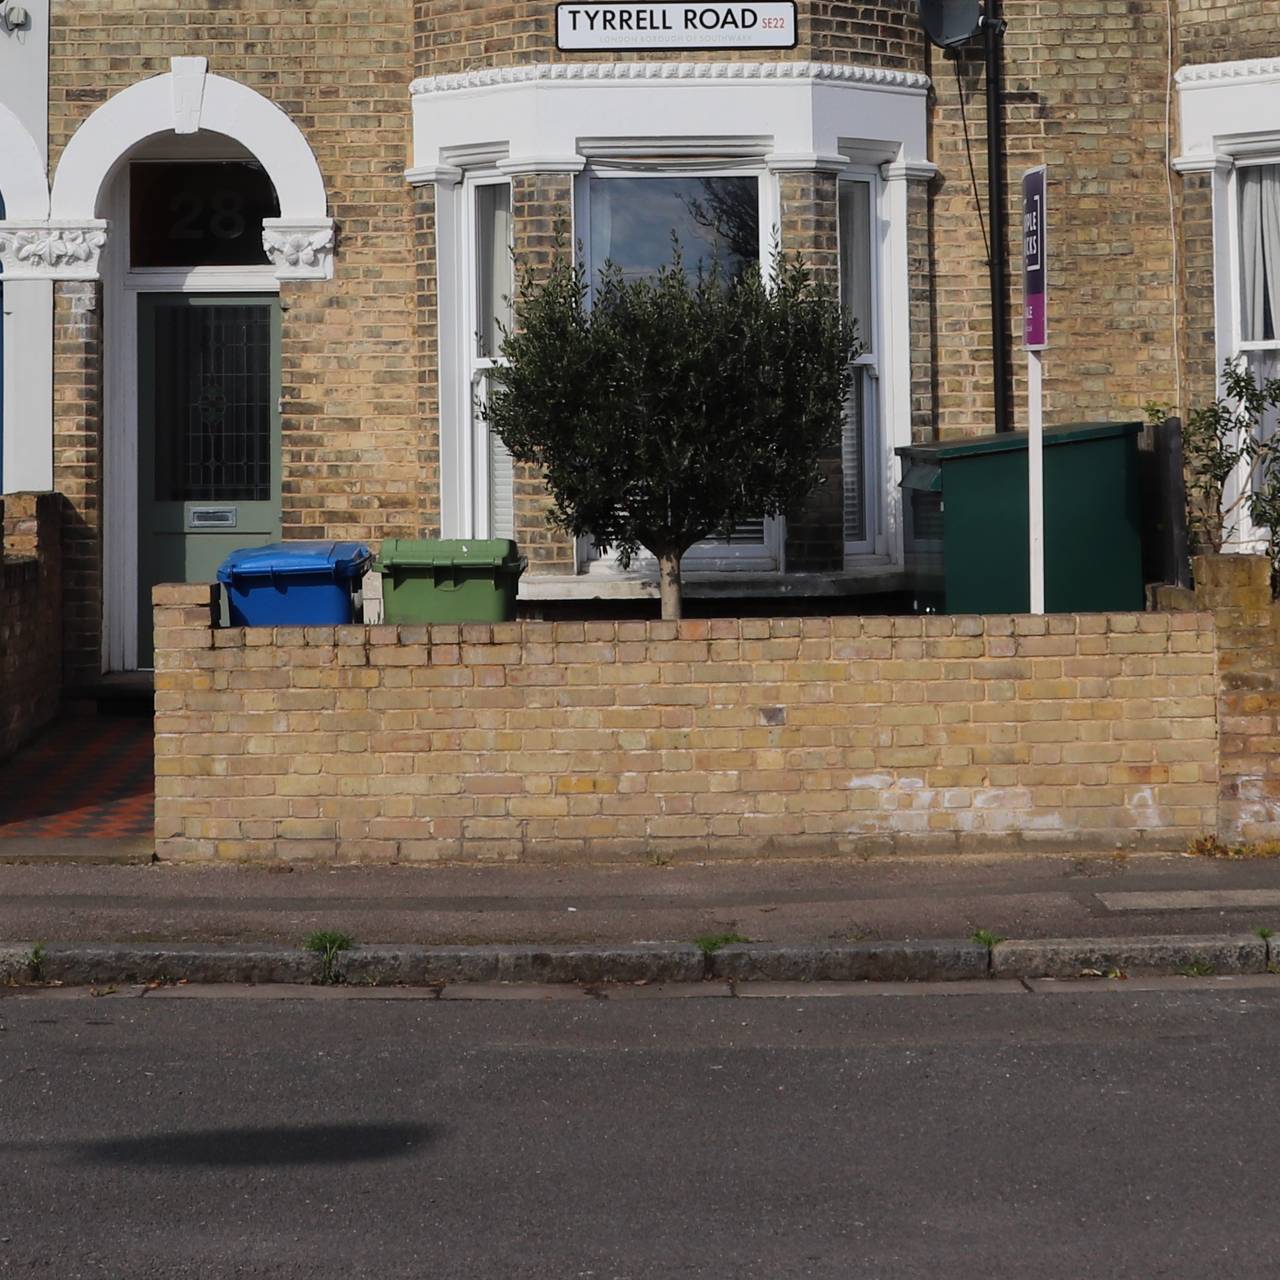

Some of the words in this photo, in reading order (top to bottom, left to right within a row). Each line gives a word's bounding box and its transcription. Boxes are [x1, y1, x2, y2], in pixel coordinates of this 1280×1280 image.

[568, 9, 673, 31] TYRRELL
[683, 7, 758, 30] ROAD
[761, 17, 786, 29] SE22
[599, 35, 638, 44] LONDON
